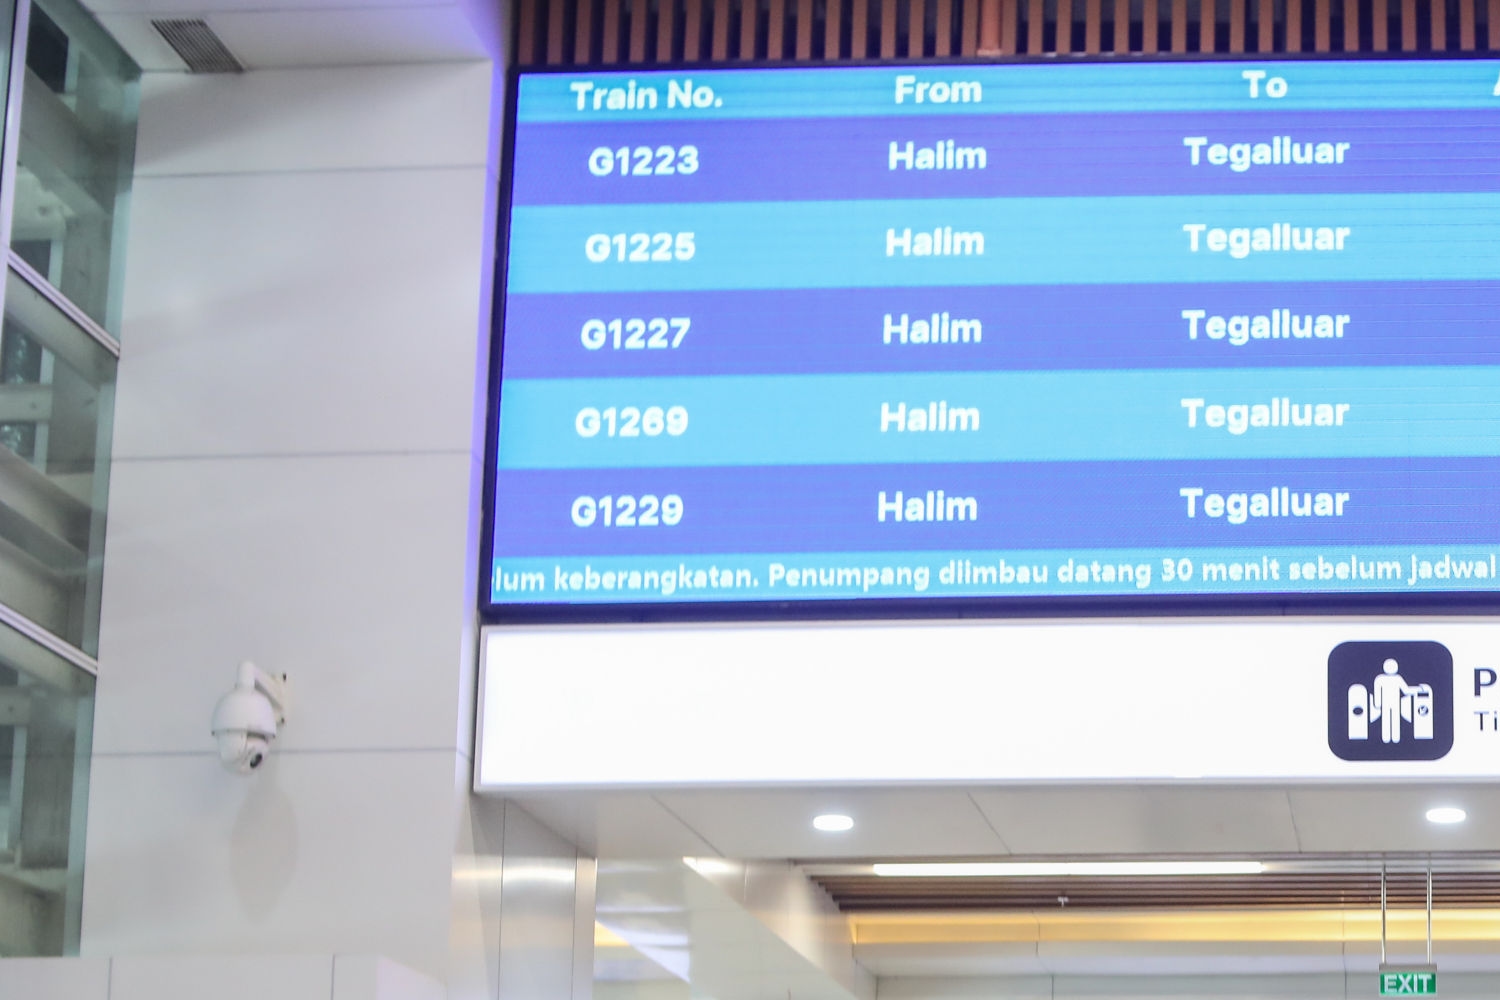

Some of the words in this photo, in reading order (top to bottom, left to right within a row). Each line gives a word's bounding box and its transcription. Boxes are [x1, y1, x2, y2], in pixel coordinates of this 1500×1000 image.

[572, 81, 657, 109] Train
[668, 81, 722, 110] No.
[896, 76, 981, 103] From
[1243, 71, 1287, 97] To
[589, 146, 698, 175] G1223
[890, 140, 986, 169] Halim
[1184, 136, 1349, 171] Tegalluar
[586, 233, 695, 262] G1225
[886, 227, 984, 256] Halim
[1183, 223, 1350, 258] Tegalluar
[581, 319, 690, 348] G1227
[884, 313, 981, 343] Halim
[1182, 309, 1350, 345] Tegalluar
[576, 406, 688, 437] G1269
[881, 401, 979, 432] Halim
[1181, 398, 1349, 434] Tegalluar
[572, 495, 683, 526] G1229
[878, 491, 977, 521] Halim
[1180, 487, 1349, 523] Tegalluar
[492, 565, 545, 591] lum
[555, 561, 758, 593] keberangkatan.
[770, 564, 929, 591] Penumpang
[1058, 559, 1151, 588] datang
[1162, 558, 1193, 581] 30
[1203, 556, 1279, 580] menit
[1290, 555, 1401, 579] sebelum
[1408, 554, 1495, 585] jadwal
[1384, 974, 1432, 993] EXIT
